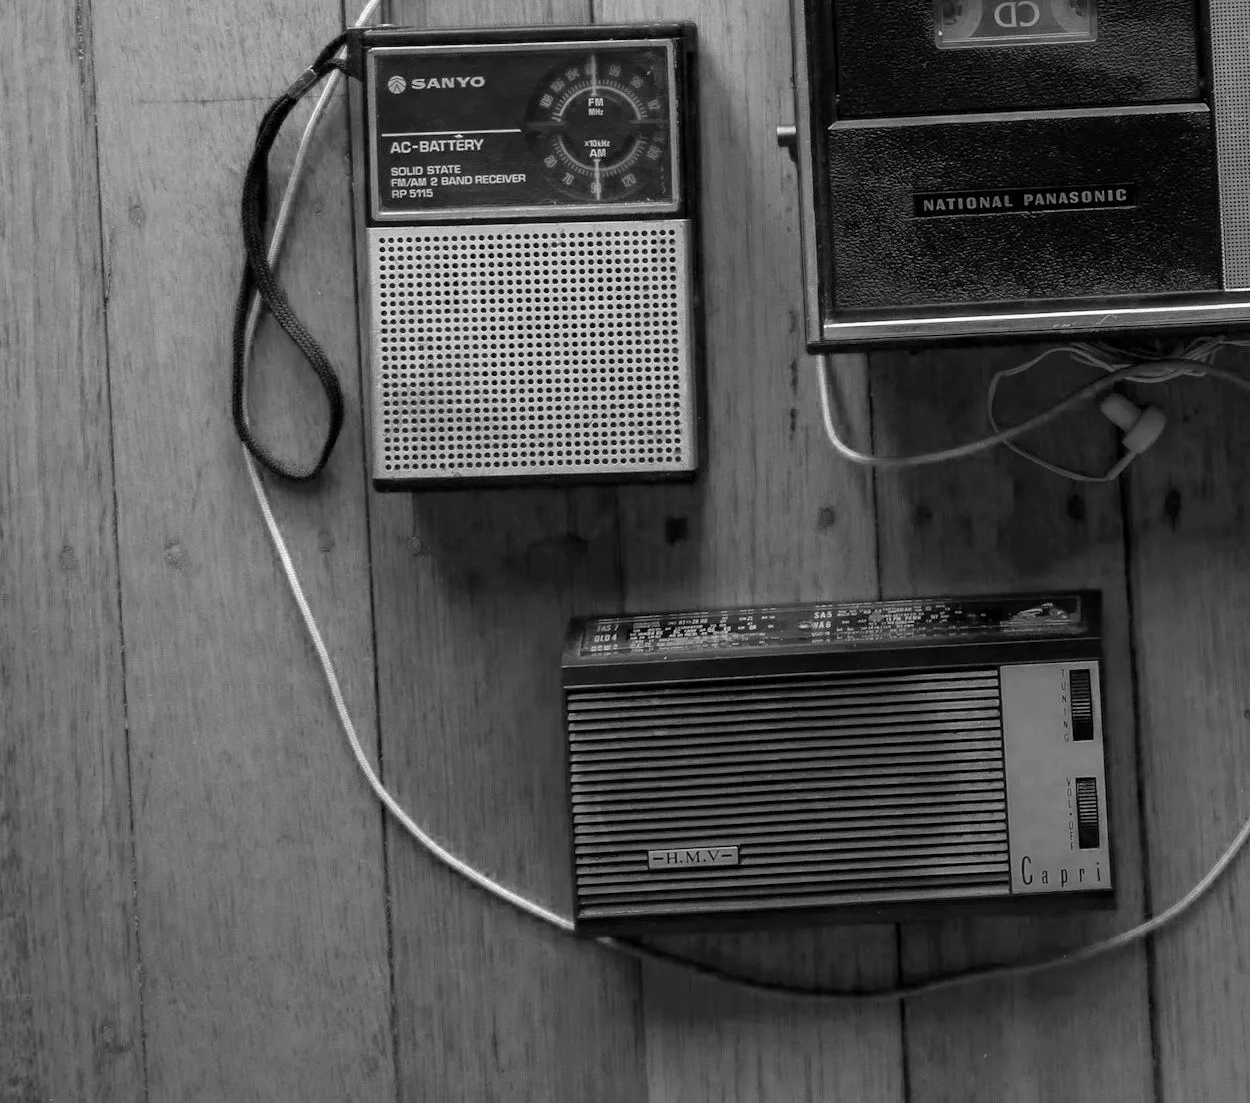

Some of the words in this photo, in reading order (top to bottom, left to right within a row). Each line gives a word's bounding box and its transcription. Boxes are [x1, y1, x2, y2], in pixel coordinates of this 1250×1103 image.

[411, 76, 486, 90] SANYO
[588, 98, 604, 107] FM
[588, 108, 604, 116] MHz
[390, 138, 485, 154] AC-BATTERY
[589, 148, 607, 157] AM
[391, 166, 423, 176] SOLID
[427, 164, 462, 175] STATE
[391, 177, 427, 187] FM/AM
[430, 177, 439, 186] 2
[441, 175, 473, 186] BAND
[475, 173, 527, 184] RECEIVER
[562, 172, 575, 185] 70
[621, 173, 637, 189] 120
[391, 189, 408, 198] RP
[409, 188, 434, 198] 5115
[923, 194, 1014, 212] NATIONAL
[1023, 188, 1127, 206] PANASONIC
[1021, 855, 1101, 888] Capri
